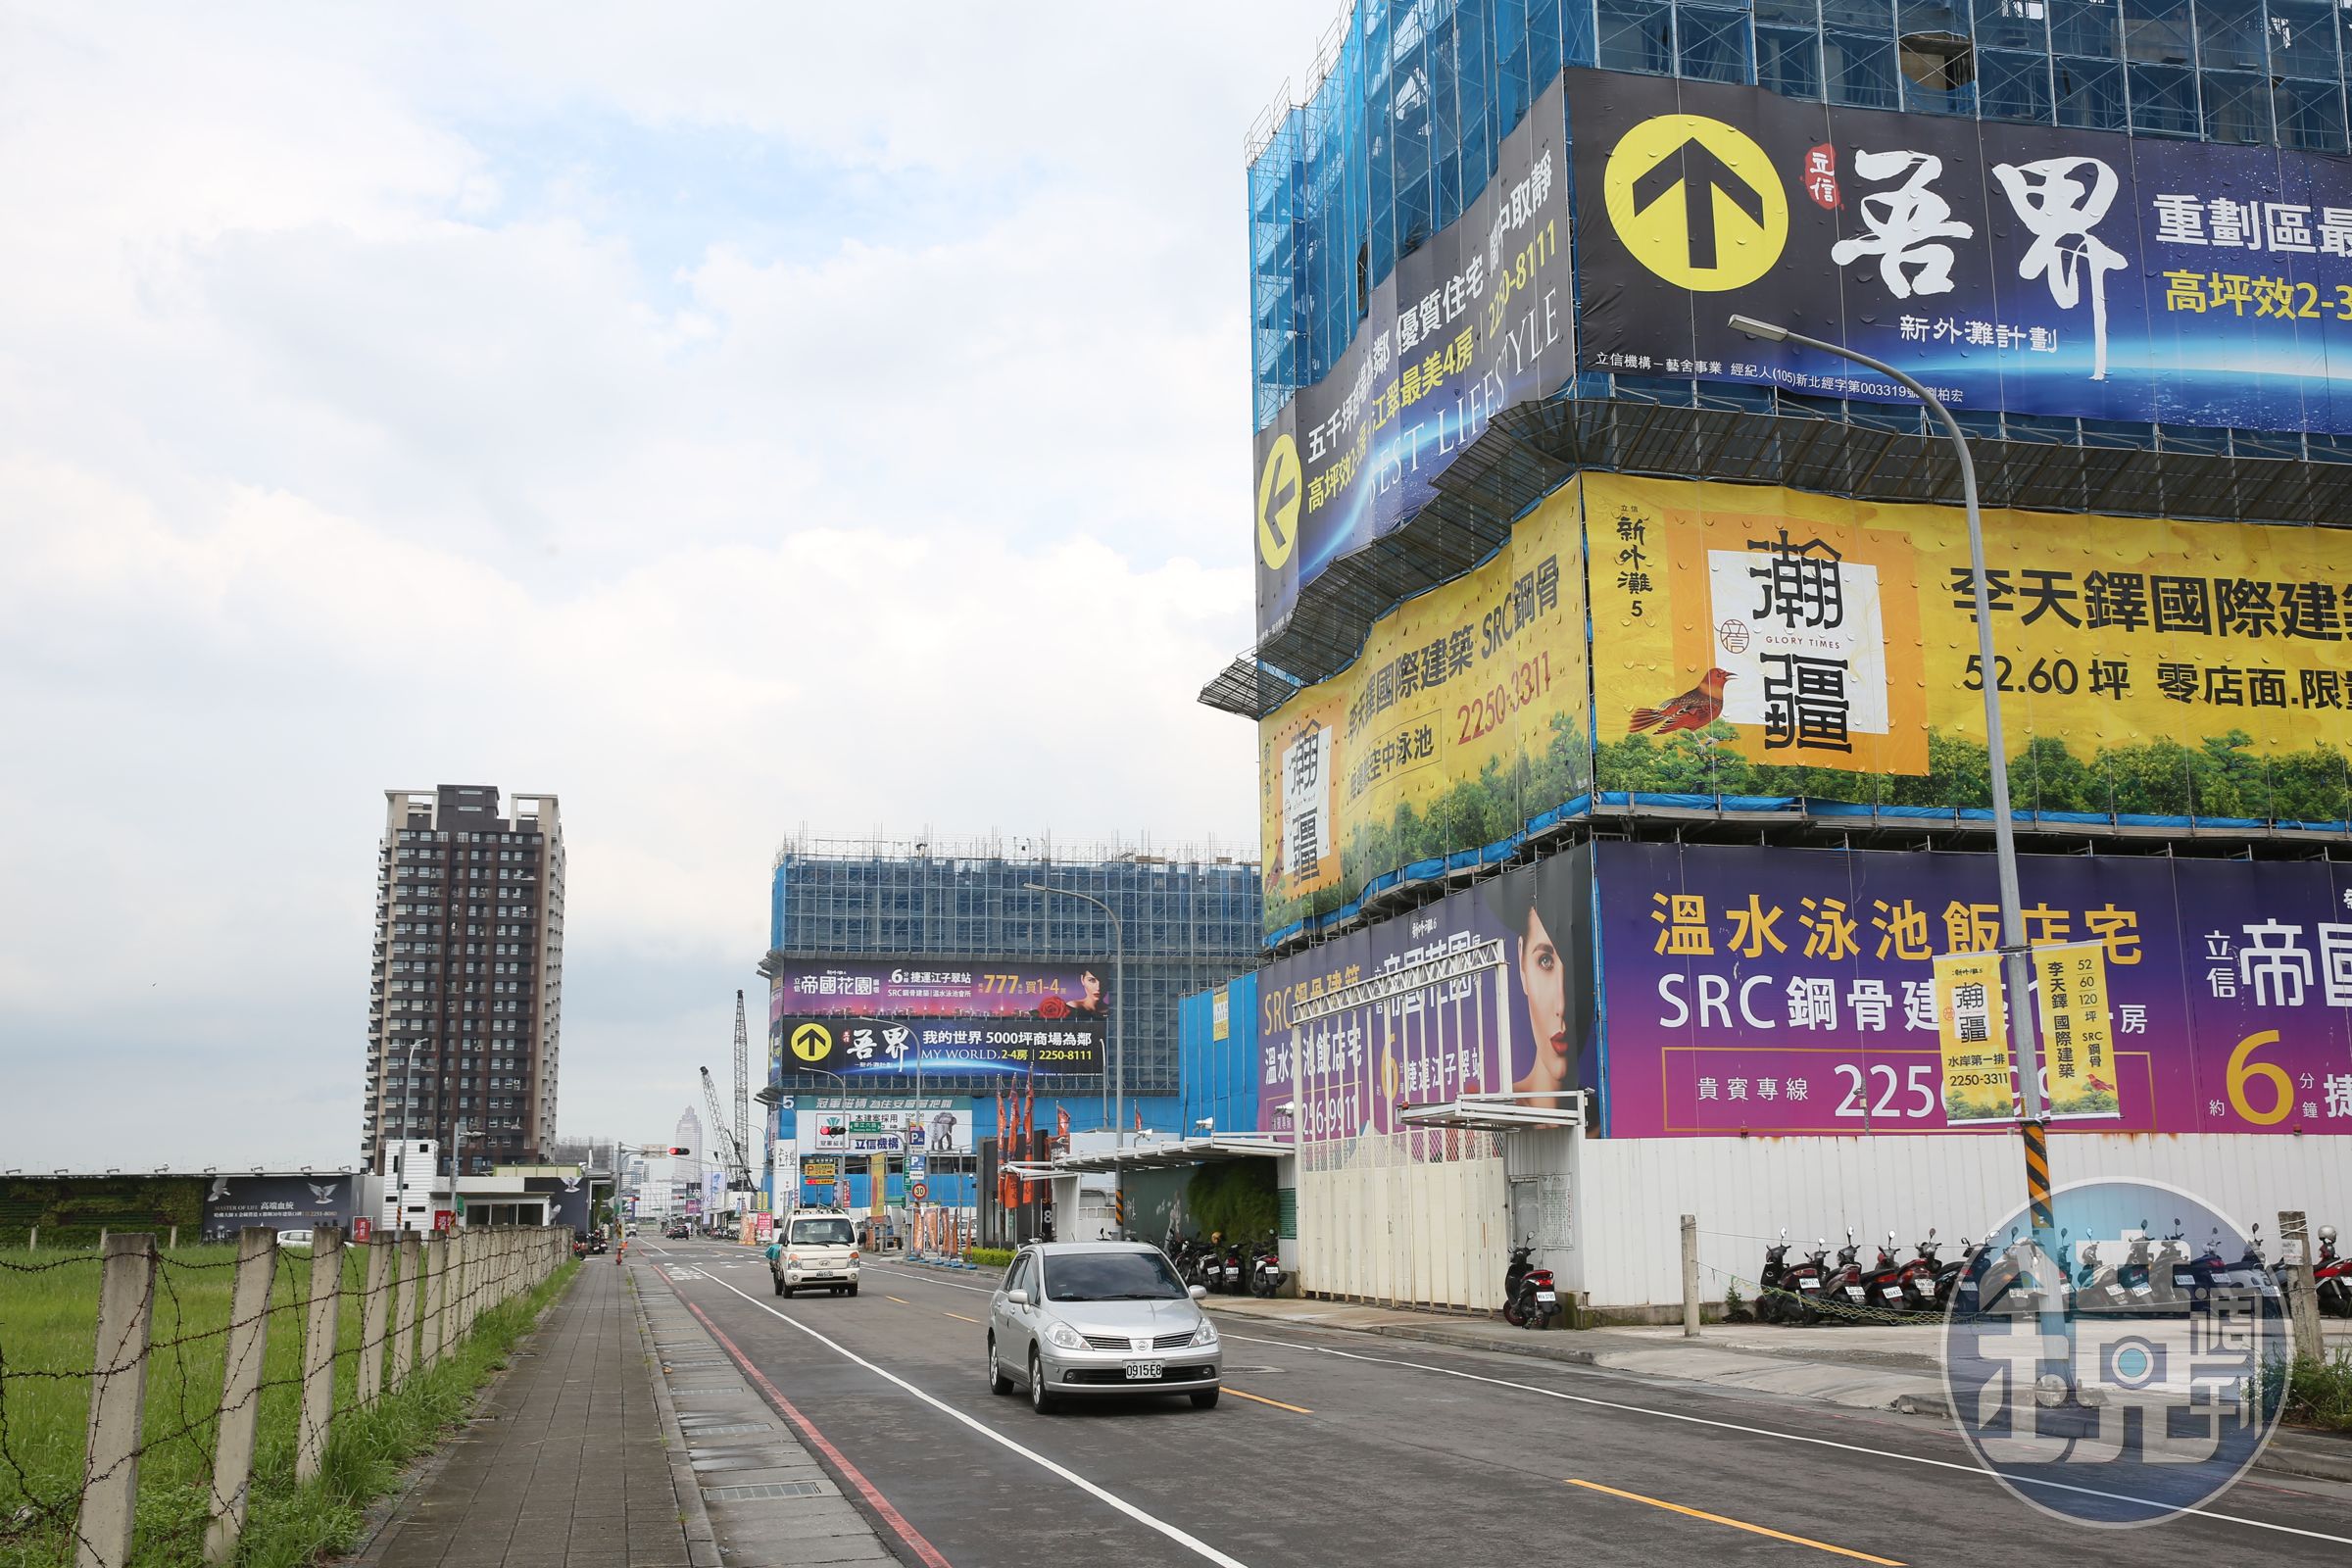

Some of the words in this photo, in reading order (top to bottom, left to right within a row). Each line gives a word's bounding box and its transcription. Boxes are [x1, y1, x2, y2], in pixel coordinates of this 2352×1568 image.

[1396, 252, 1485, 359] 優質住宅
[1899, 314, 2057, 353] 新外灘計劃
[1481, 554, 1559, 661] SRC鋼骨
[1950, 566, 2352, 642] 李天鐸國際建
[1765, 635, 1803, 646] GLORY
[1809, 638, 1841, 650] TIMES
[2157, 662, 2352, 711] 零店面.限
[1457, 651, 1551, 746] 2250-3311
[2077, 958, 2093, 971] 52
[2204, 929, 2236, 998] 立信
[801, 974, 872, 996] 帝國花園
[2079, 976, 2095, 988] 60
[2079, 993, 2098, 1005] 120
[922, 1030, 982, 1045] 我的世界
[986, 1031, 1092, 1047] 5000坪商場為鄰
[2082, 1031, 2104, 1041] SRC
[920, 1049, 942, 1059] MY
[1039, 1050, 1093, 1060] 2250-8111
[1264, 1027, 1362, 1085] 溫水池飯店宅
[1947, 1053, 2006, 1068] 水岸第一排
[1949, 1072, 2009, 1088] 2250-3311
[1697, 1076, 1809, 1102] 貴賓專線
[855, 1137, 900, 1151] 立信機構
[1044, 1209, 1053, 1223] 8
